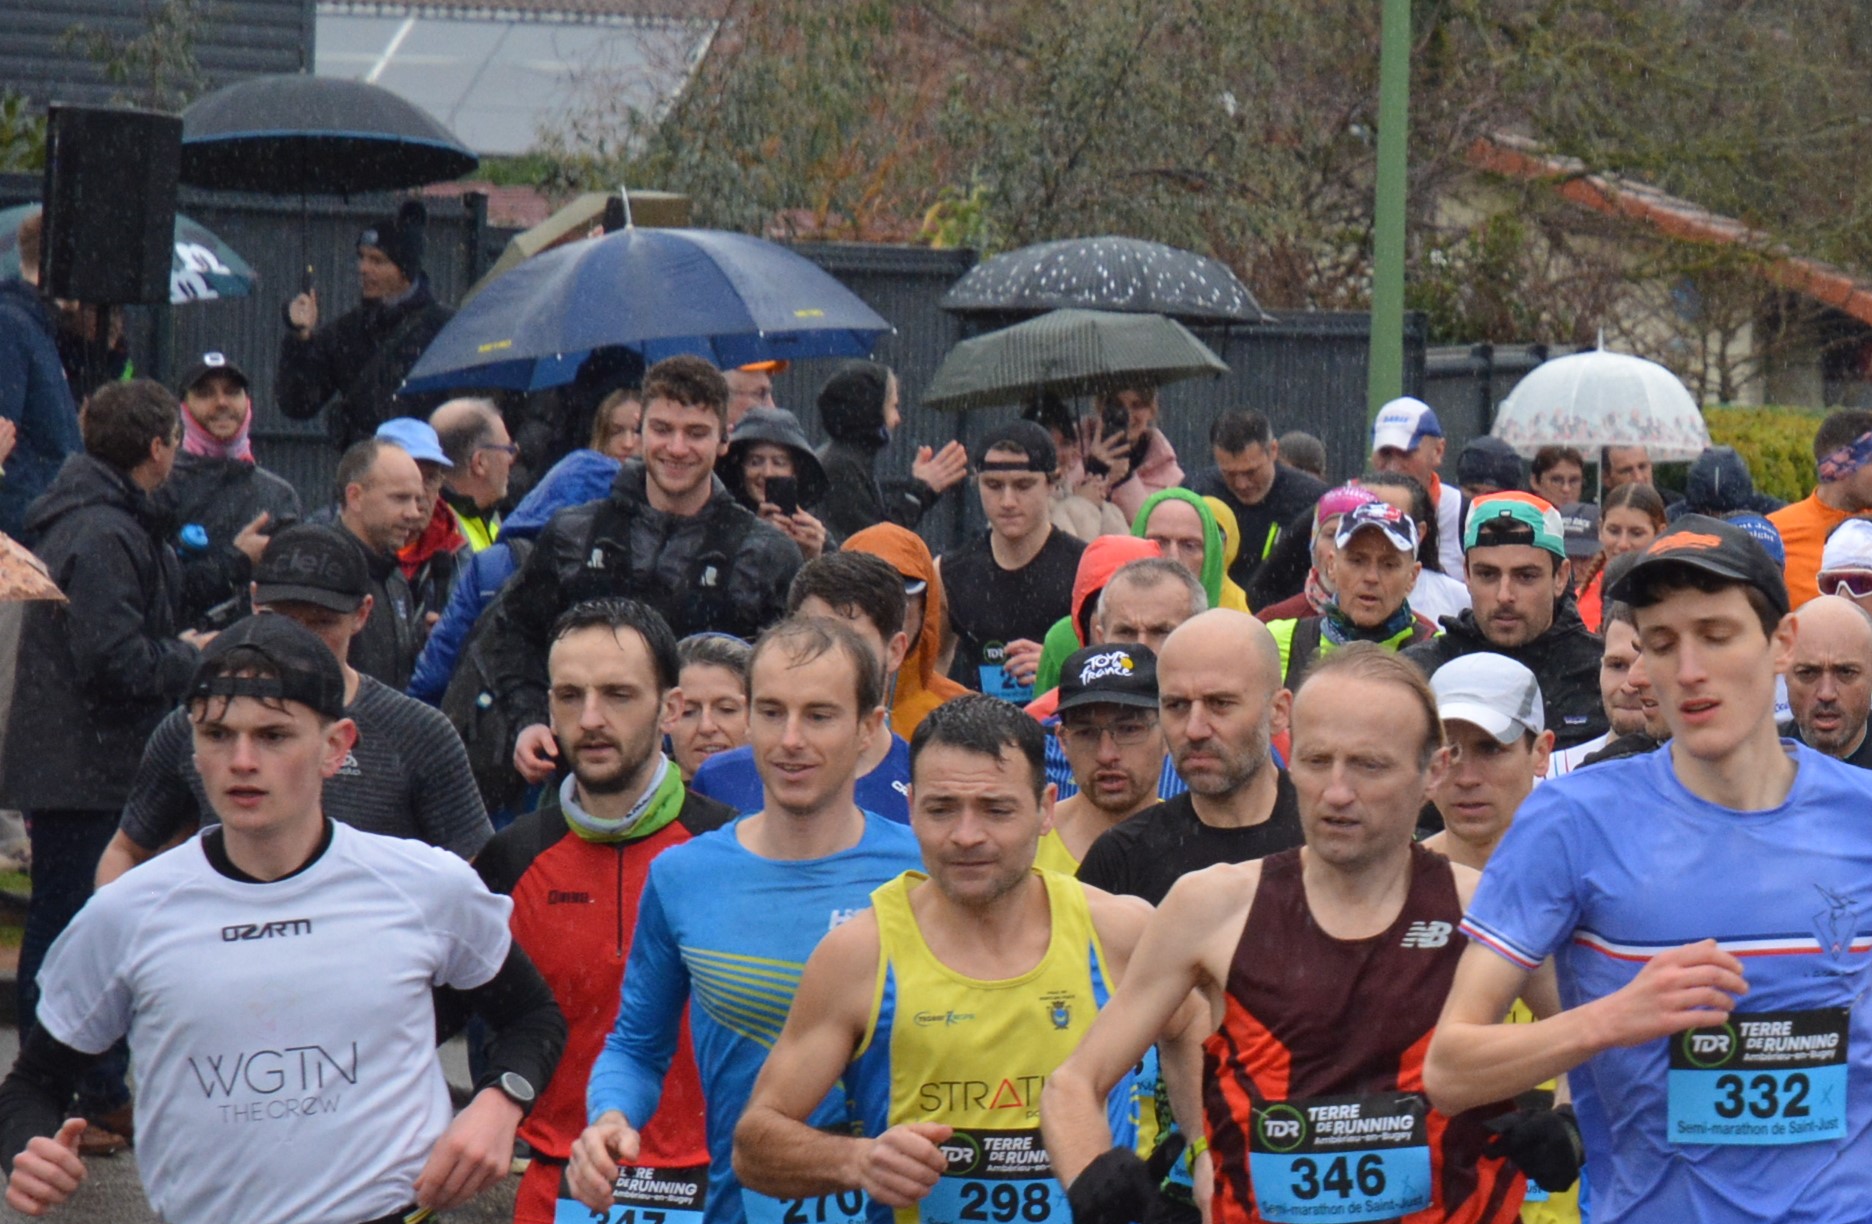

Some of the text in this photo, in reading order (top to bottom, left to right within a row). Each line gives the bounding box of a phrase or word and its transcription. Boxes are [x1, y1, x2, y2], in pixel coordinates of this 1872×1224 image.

[1740, 1021, 1793, 1037] TERRE
[1692, 1034, 1730, 1053] TDR
[1746, 1033, 1839, 1052] DE RUNNING
[188, 1040, 358, 1099] WGTN
[1714, 1072, 1810, 1119] 332
[1307, 1104, 1361, 1121] TERRE
[1264, 1120, 1301, 1137] TDR
[1315, 1115, 1415, 1135] DE RUNNING
[1677, 1118, 1839, 1135] Semi-marathon de Saint-Just
[983, 1137, 1033, 1150] TERRE
[989, 1152, 1005, 1162] DE
[1291, 1154, 1386, 1200] 346
[629, 1179, 698, 1196] RUNNING
[959, 1181, 1051, 1223] 298
[1349, 1201, 1362, 1214] de
